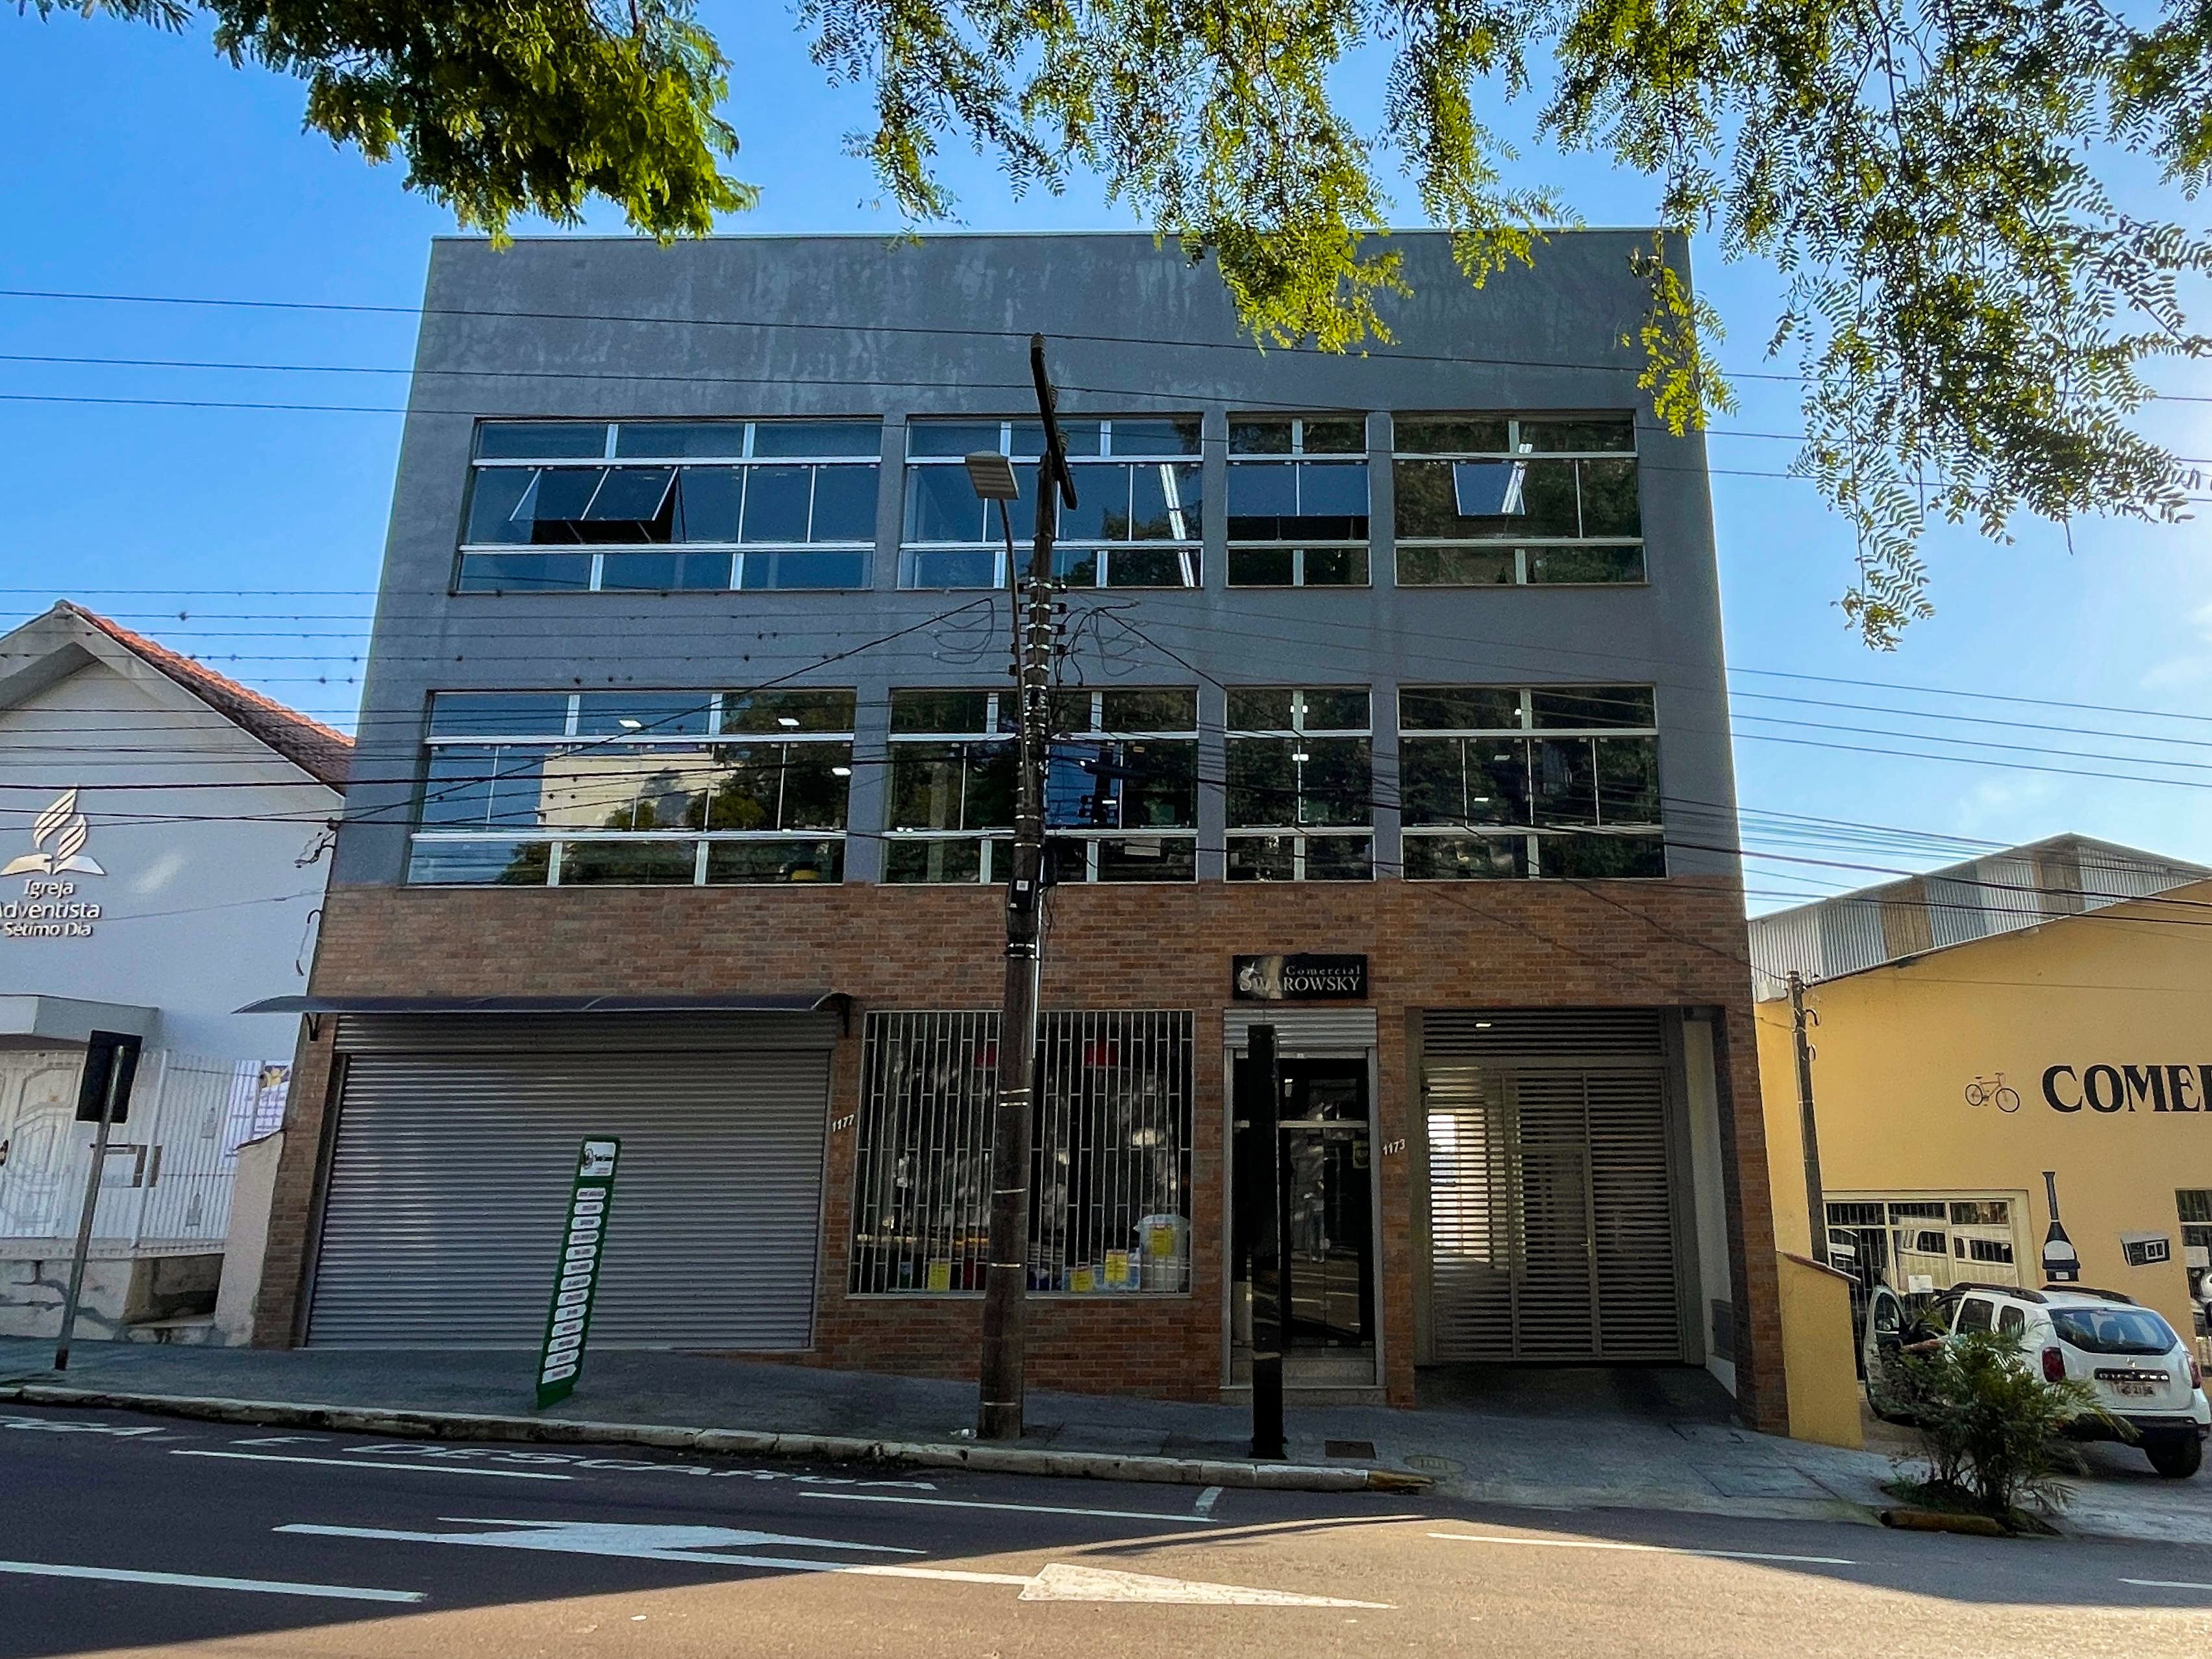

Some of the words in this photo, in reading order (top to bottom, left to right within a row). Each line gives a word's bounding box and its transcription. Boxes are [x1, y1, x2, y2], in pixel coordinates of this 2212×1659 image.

[23, 879, 75, 899] Igreja
[66, 922, 92, 936] Dia
[1286, 965, 1360, 975] Comercial
[832, 1114, 854, 1132] 1177
[1383, 1138, 1405, 1156] 1173
